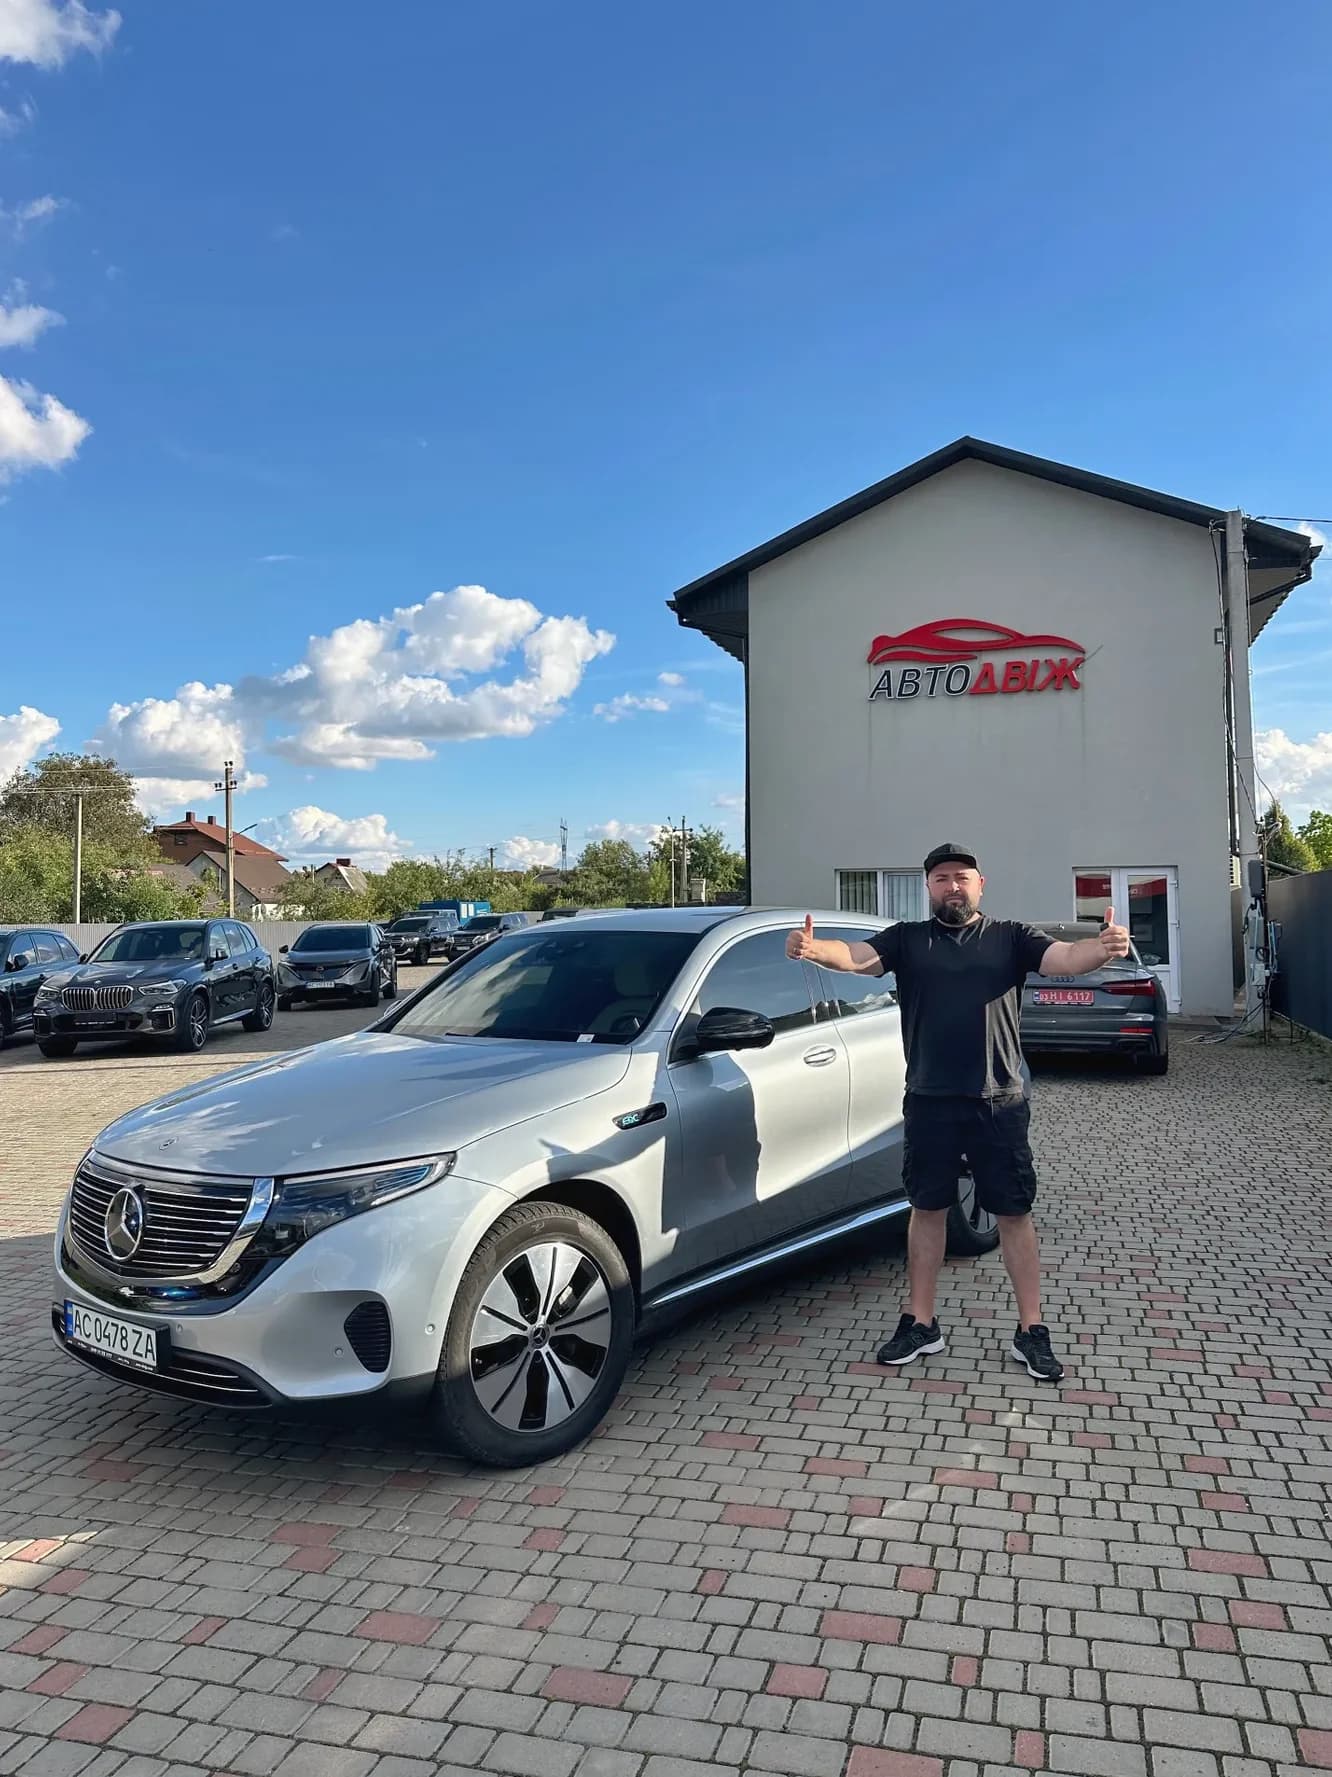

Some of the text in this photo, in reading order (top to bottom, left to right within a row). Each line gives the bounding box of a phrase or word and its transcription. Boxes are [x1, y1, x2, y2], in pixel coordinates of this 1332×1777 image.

[869, 657, 1085, 700] АВТОДВІЖ
[94, 1317, 129, 1352] 0478
[131, 1328, 156, 1362] ZA
